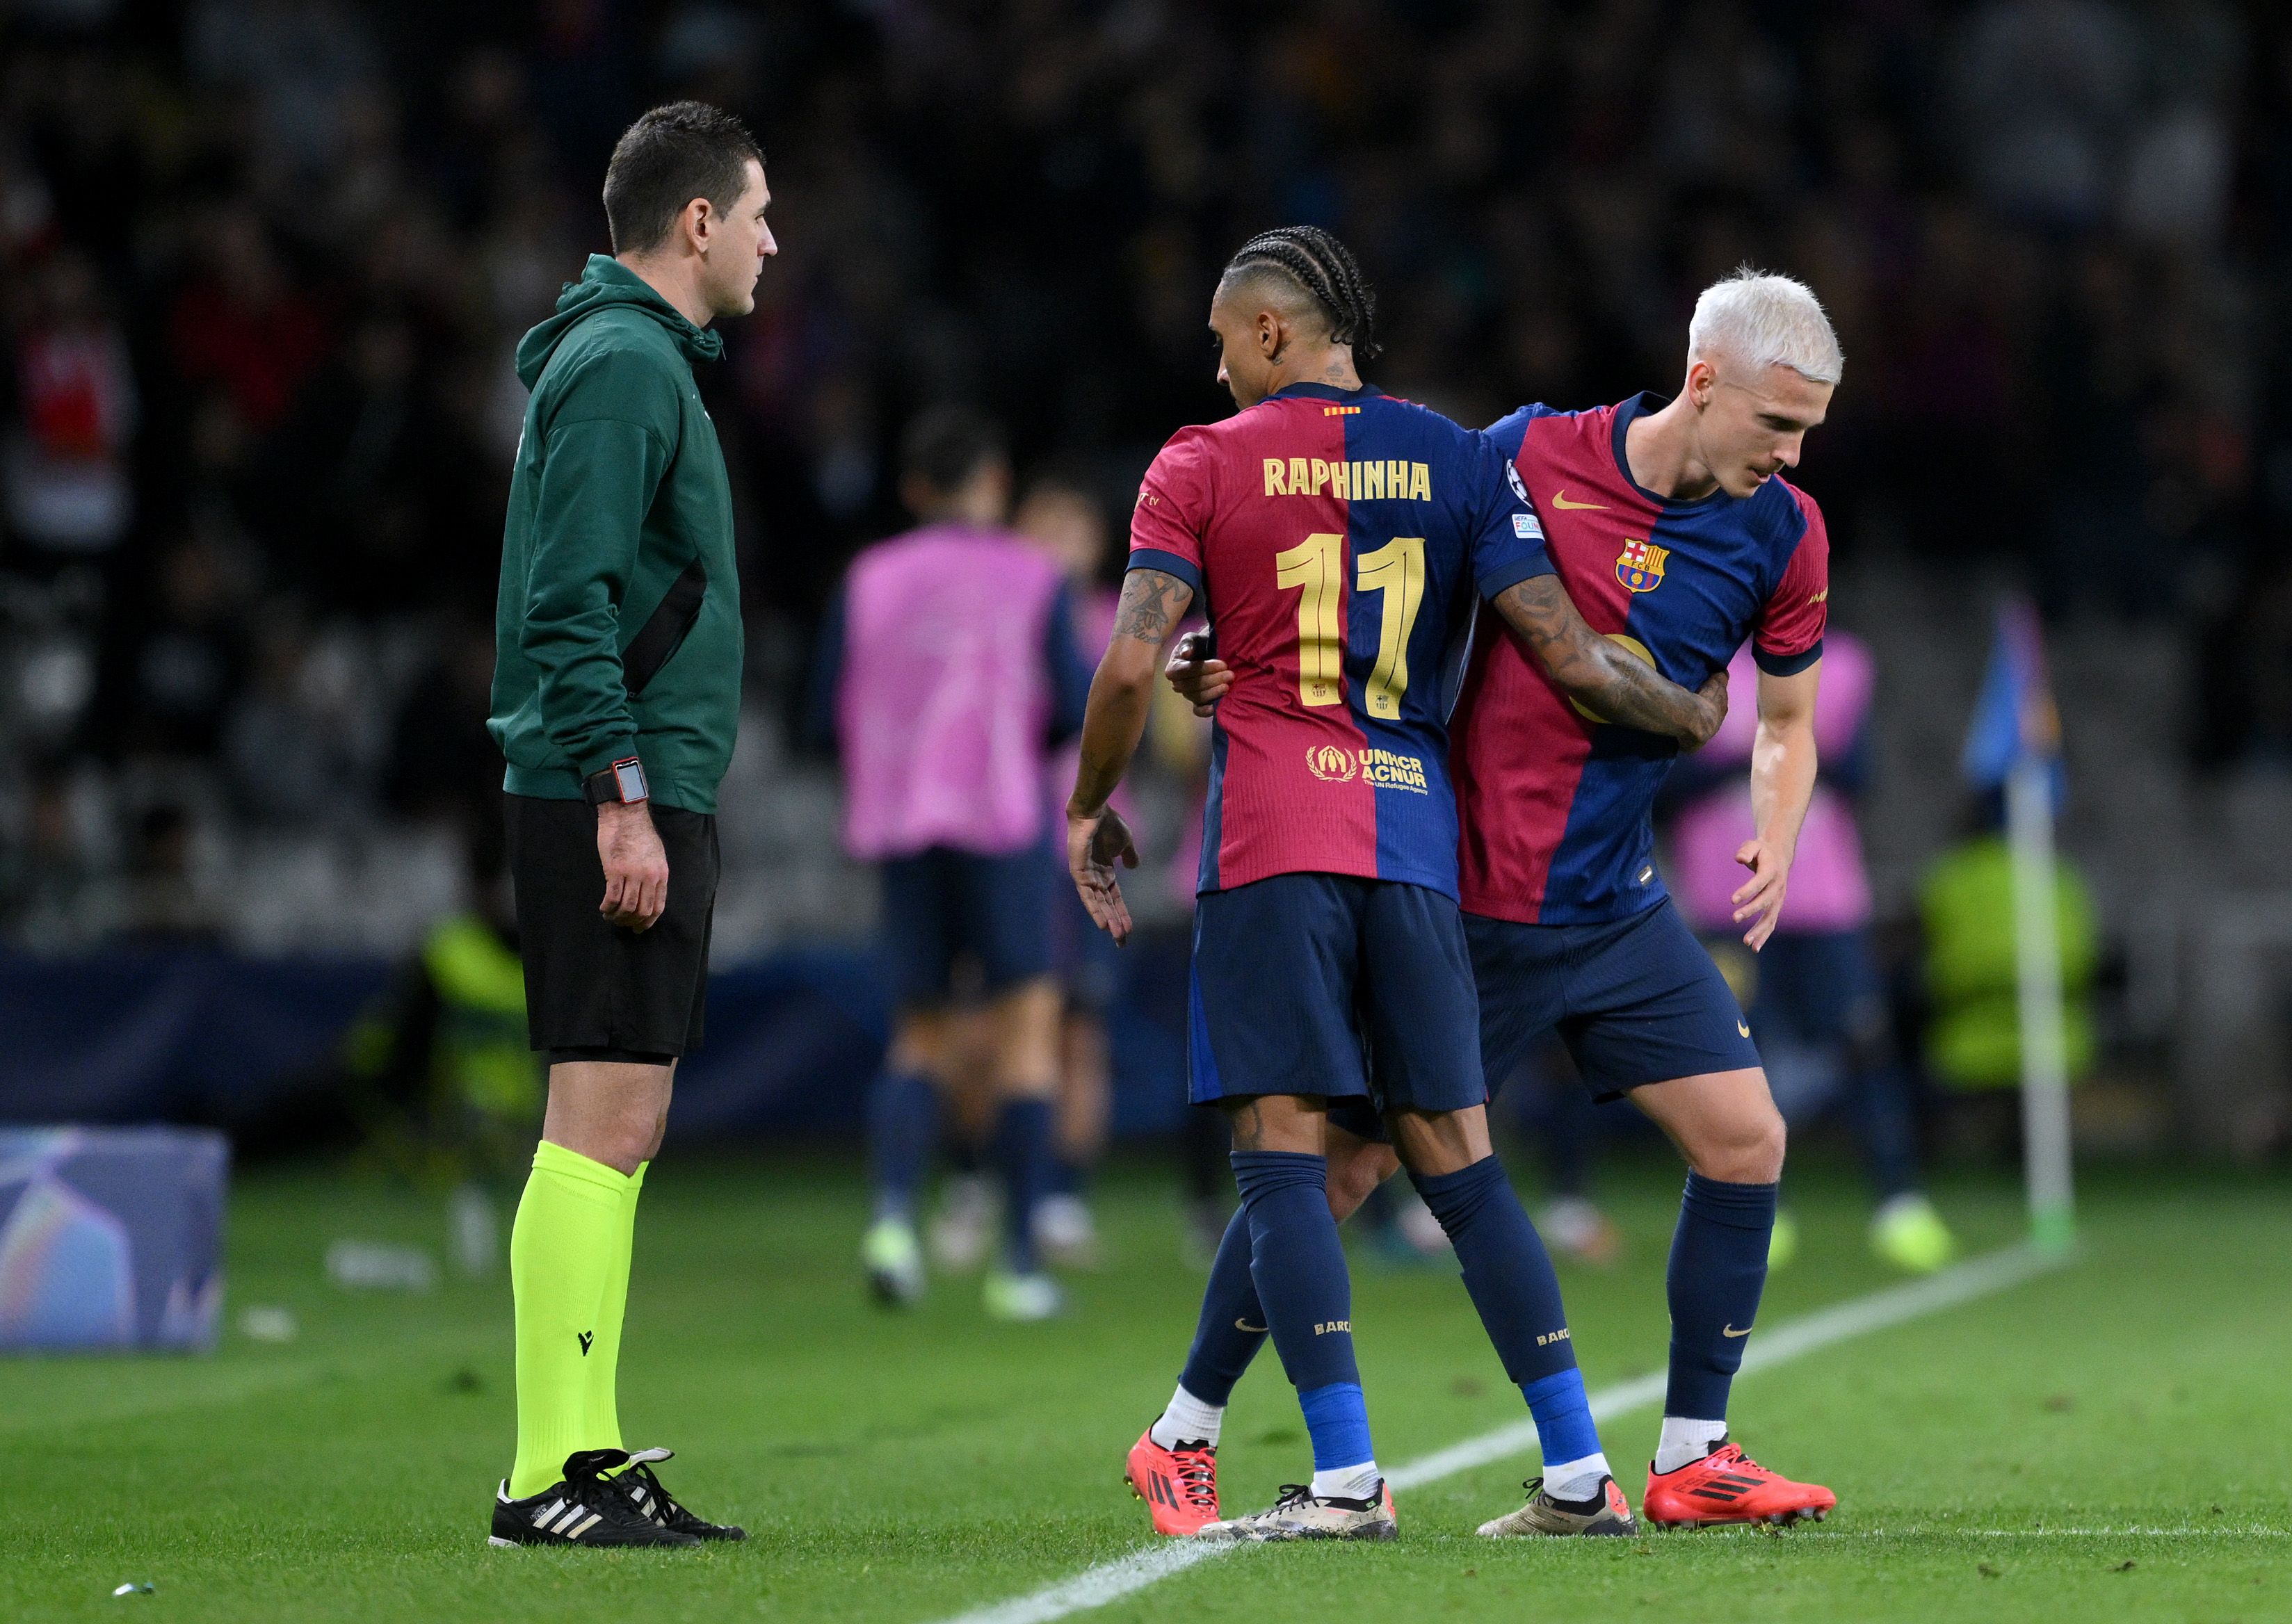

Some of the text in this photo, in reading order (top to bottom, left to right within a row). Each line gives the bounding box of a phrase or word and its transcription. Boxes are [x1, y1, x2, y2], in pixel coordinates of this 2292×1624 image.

[1263, 457, 1432, 501] RAPHINHA
[1275, 533, 1426, 721] 11
[1358, 749, 1423, 773] UNHCR
[1362, 765, 1428, 788] ACNUR
[1385, 783, 1410, 791] Refugee
[1410, 786, 1428, 796] Agency
